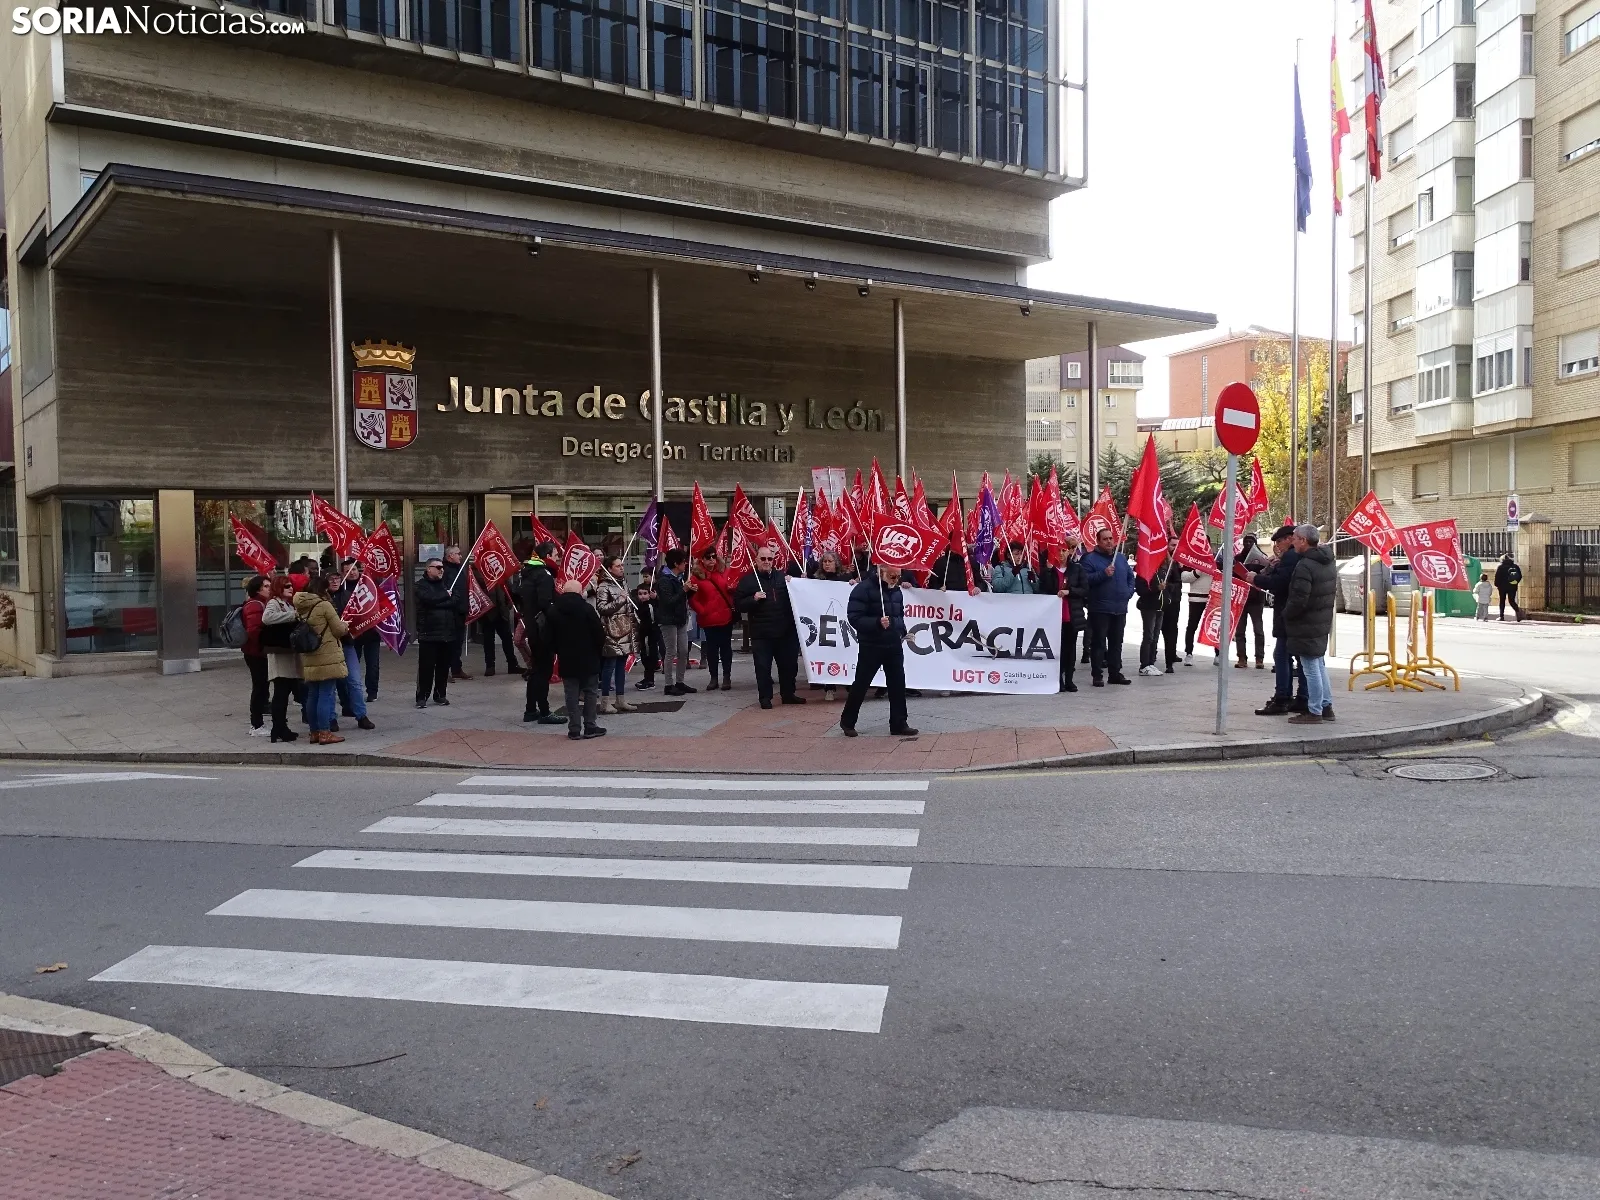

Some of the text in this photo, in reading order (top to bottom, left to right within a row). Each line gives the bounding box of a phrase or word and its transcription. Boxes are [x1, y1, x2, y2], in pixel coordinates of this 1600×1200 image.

[437, 376, 885, 436] Junta de Castilla y León
[562, 436, 795, 463] Delegacón Territorial
[235, 530, 258, 557] UGT
[881, 528, 918, 550] UGT
[372, 548, 388, 570] UGT
[487, 553, 504, 573] UGT
[1429, 555, 1452, 580] UGT
[355, 606, 390, 631] www.ugt.es
[903, 603, 963, 622] amos la
[952, 669, 985, 683] UGT
[1003, 671, 1027, 679] Castilla
[1033, 672, 1047, 680] León
